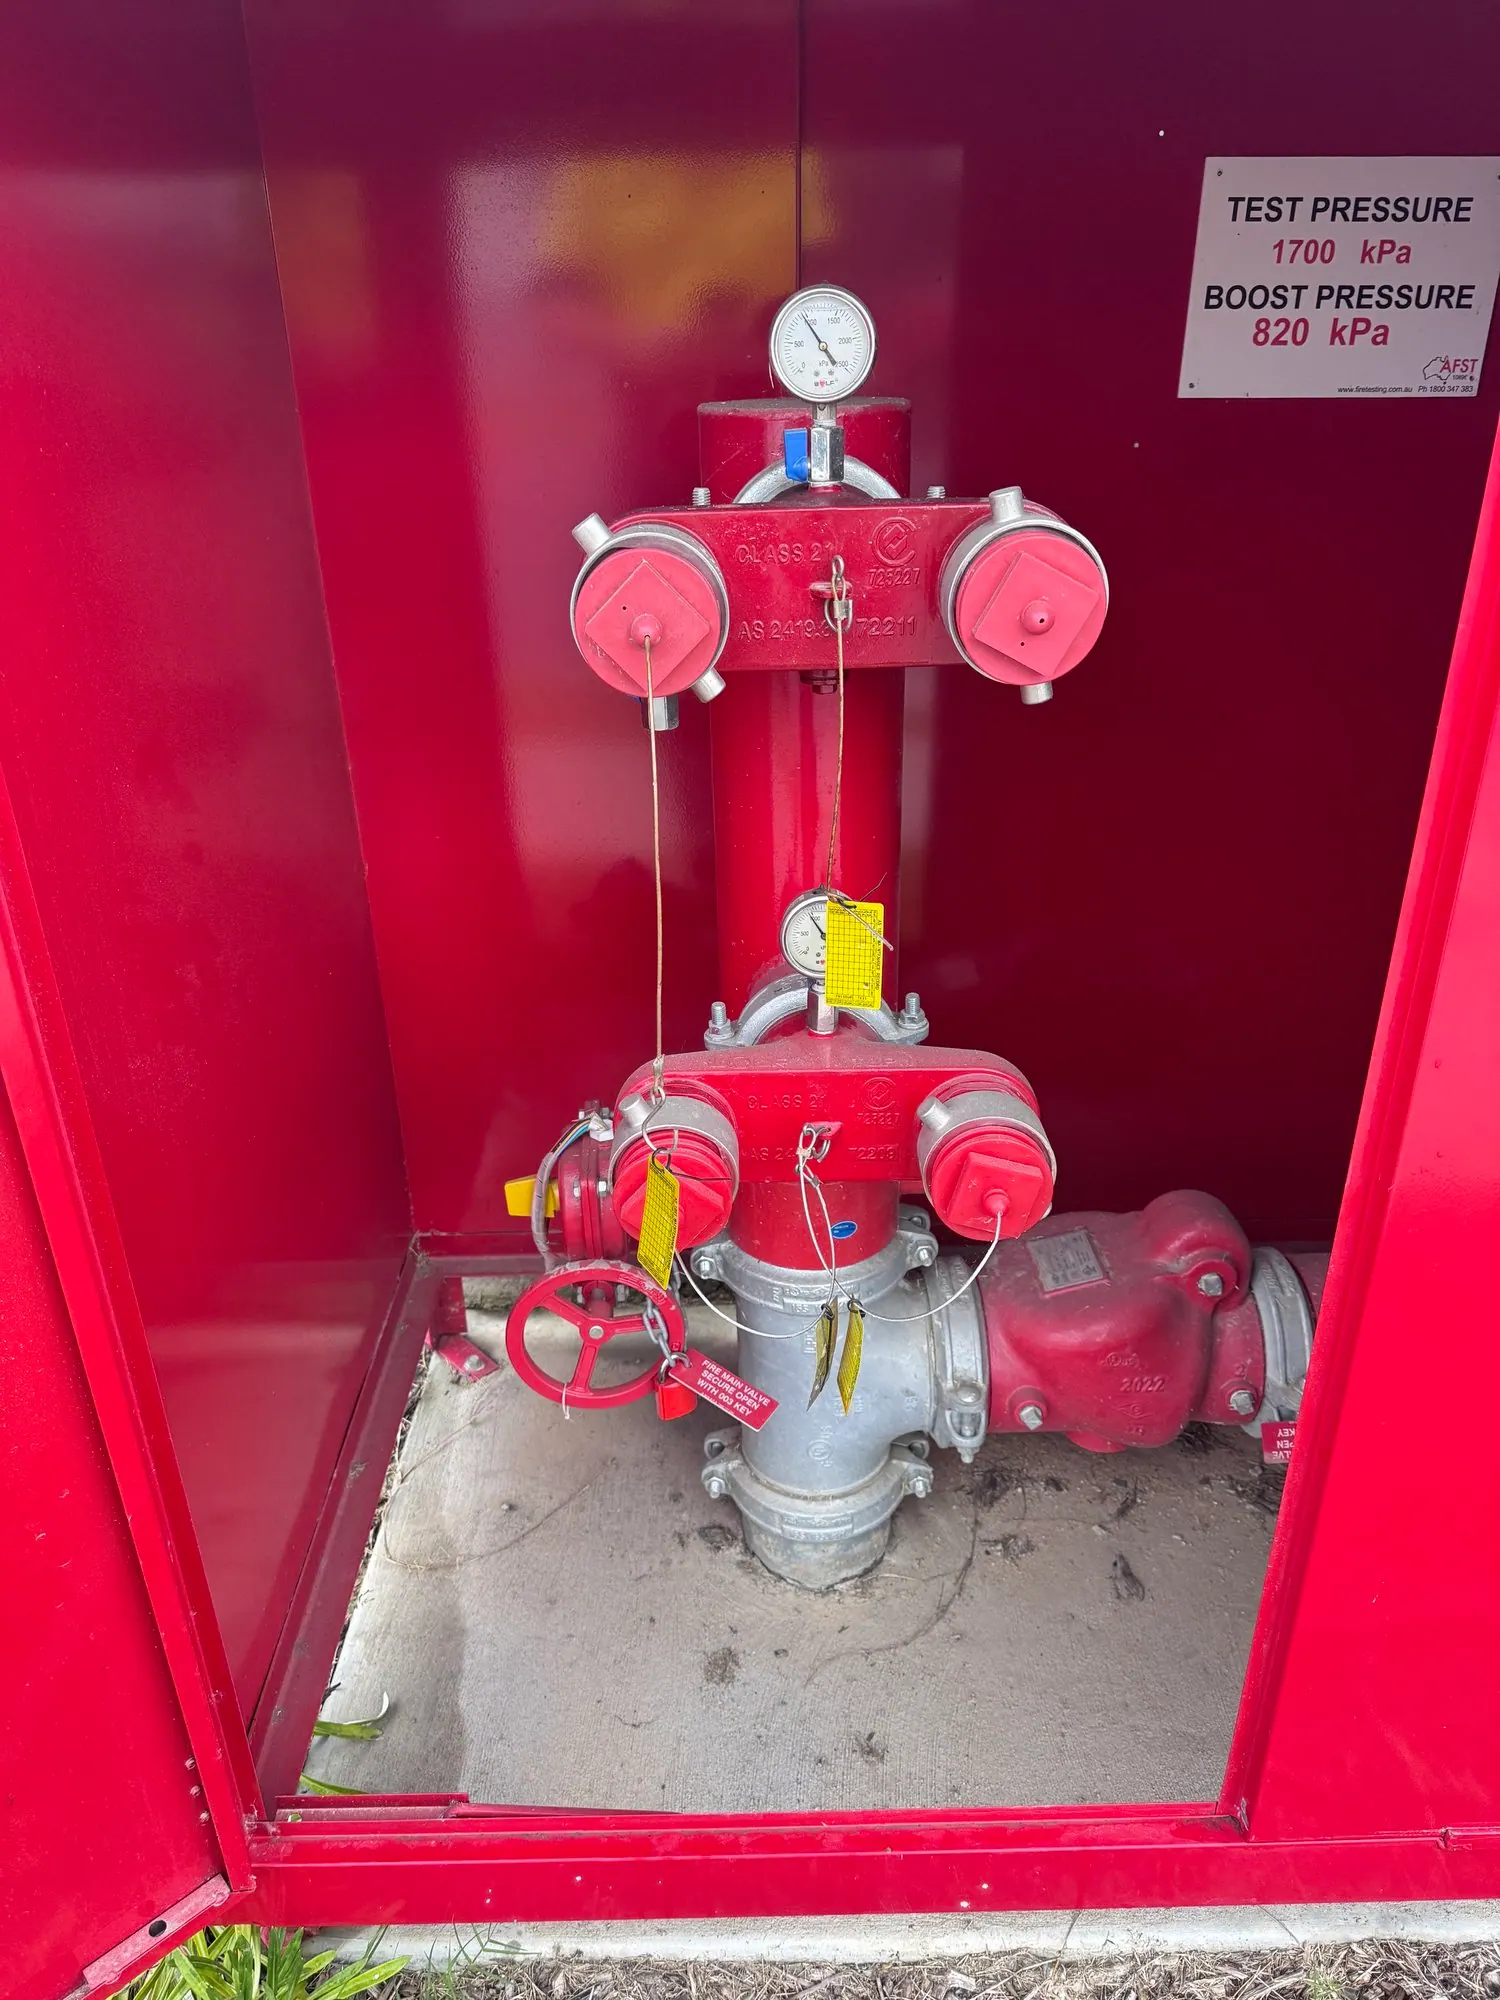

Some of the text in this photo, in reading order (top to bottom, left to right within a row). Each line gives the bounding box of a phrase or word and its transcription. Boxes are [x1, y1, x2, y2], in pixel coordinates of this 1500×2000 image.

[1227, 196, 1474, 223] TEST PRESSURE
[1272, 239, 1412, 264] 1700 kPa
[1204, 285, 1476, 310] BOOST PRESSURE
[794, 340, 804, 348] 500
[1252, 318, 1390, 347] 820 kPa
[1440, 359, 1479, 373] AFST
[1337, 385, 1413, 394] www.firetesting.com.au
[735, 543, 804, 565] CLASS
[868, 567, 920, 588] 725227
[738, 620, 765, 640] AS
[856, 616, 917, 637] 72211
[701, 1359, 720, 1375] FIRE
[722, 1371, 744, 1390] MAIN
[743, 1386, 770, 1407] VALVE
[701, 1369, 737, 1394] SECURE
[735, 1391, 760, 1410] OPEN
[1120, 1375, 1165, 1393] 2022
[697, 1378, 719, 1397] WITH
[718, 1392, 734, 1405] 003
[733, 1402, 752, 1417] KEY
